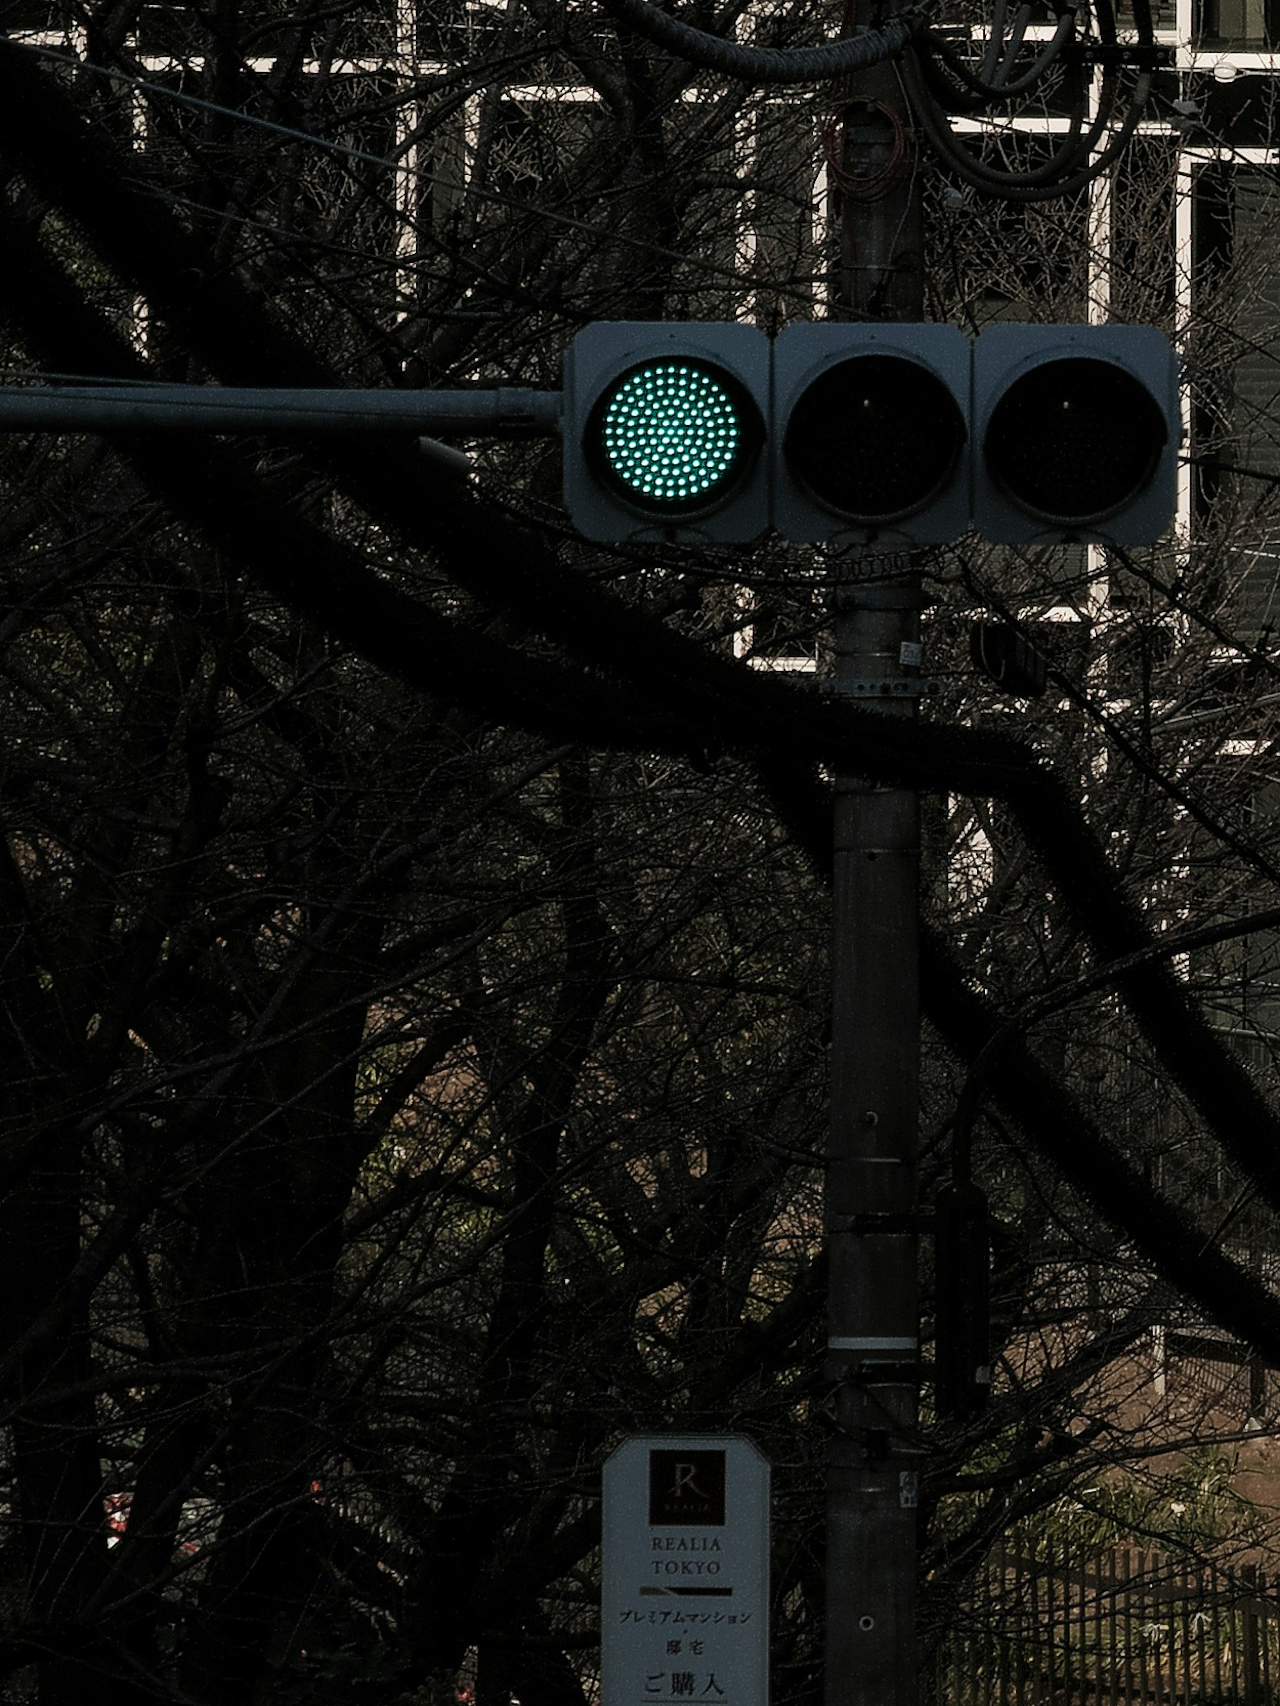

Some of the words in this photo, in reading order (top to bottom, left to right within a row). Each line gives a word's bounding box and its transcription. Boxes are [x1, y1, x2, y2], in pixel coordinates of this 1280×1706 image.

[652, 1537, 721, 1551] REALIA
[652, 1560, 721, 1575] TOKYO
[619, 1609, 752, 1625] プレミアムマンション
[644, 1672, 725, 1696] ご購入
